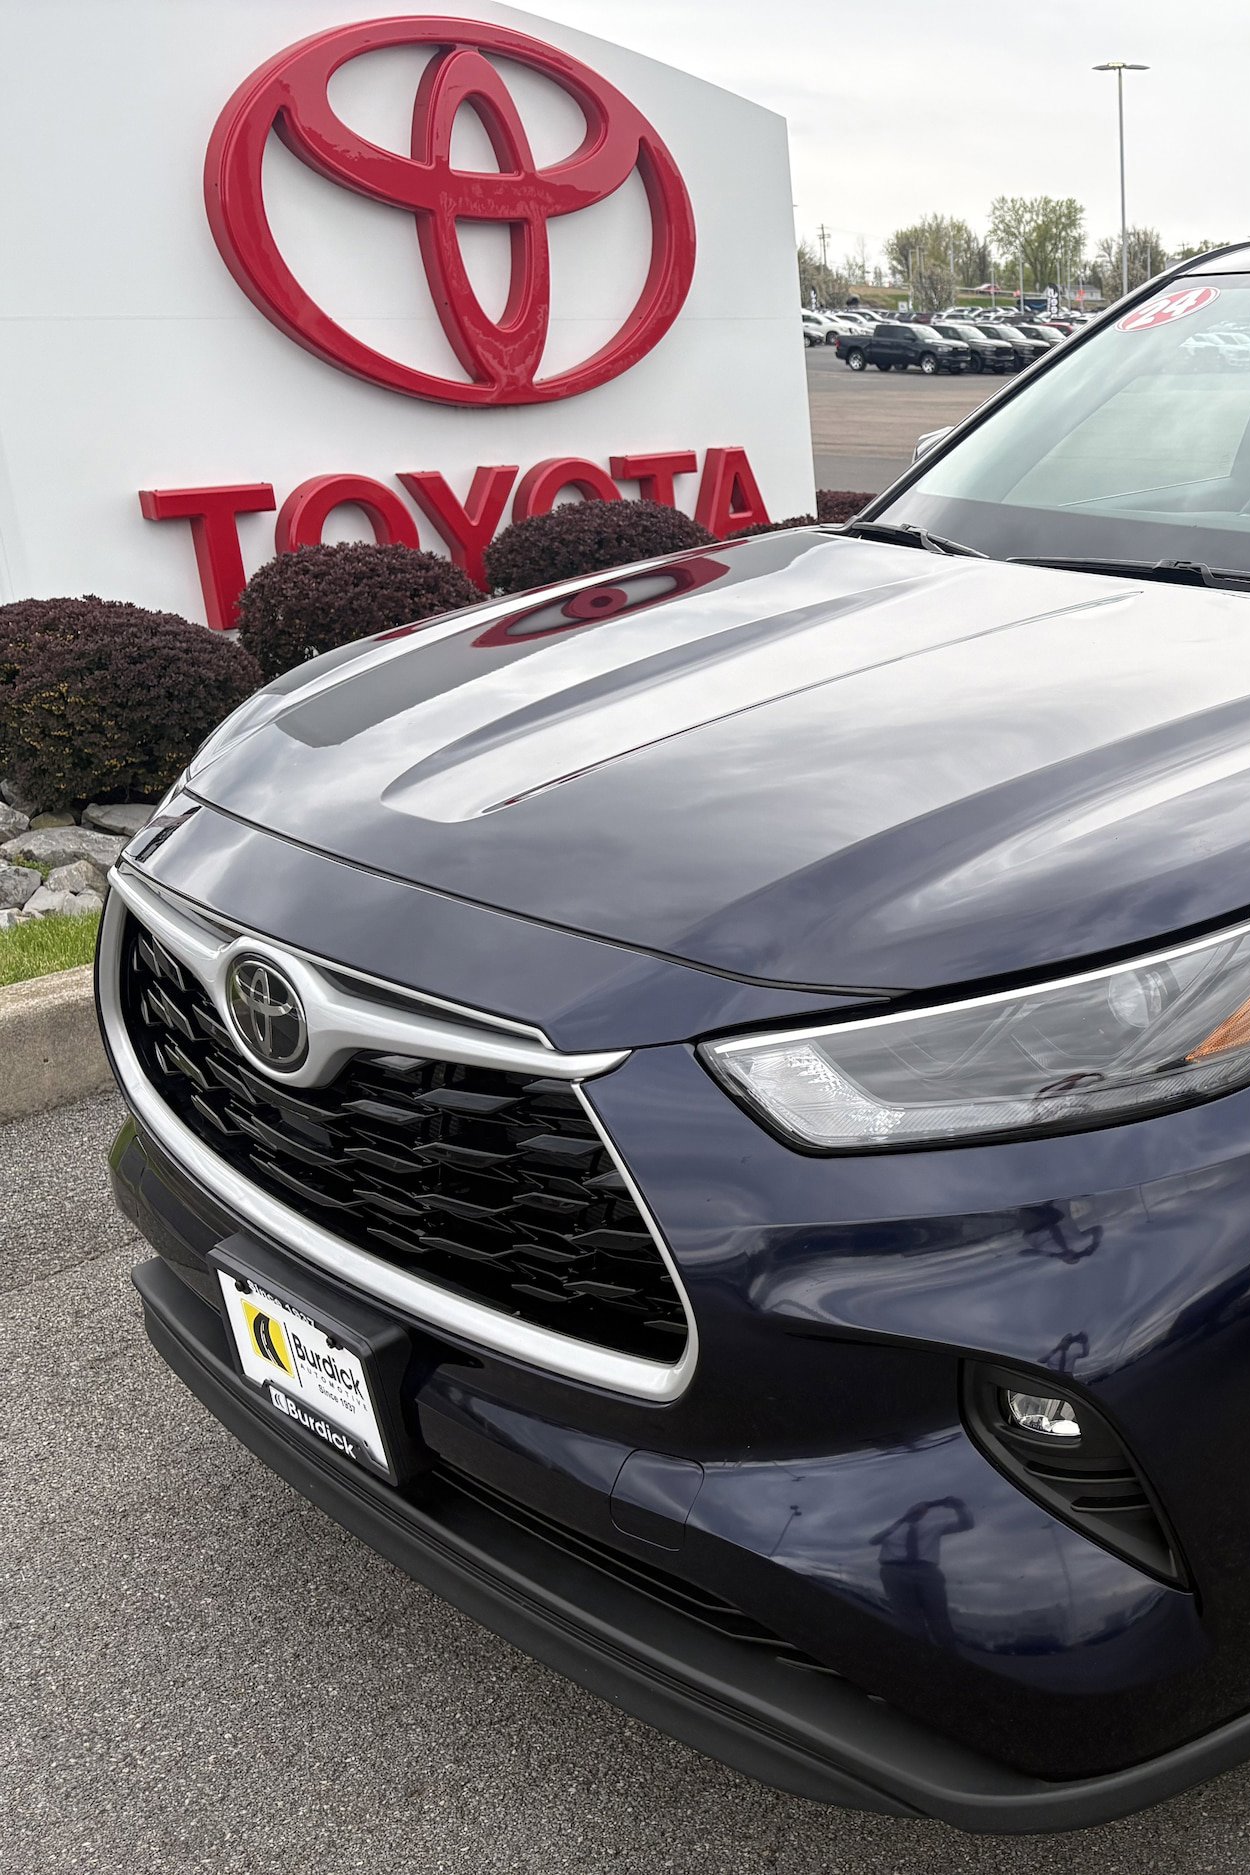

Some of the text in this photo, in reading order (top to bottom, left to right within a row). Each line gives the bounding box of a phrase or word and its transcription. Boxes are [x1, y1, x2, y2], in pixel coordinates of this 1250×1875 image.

[1123, 288, 1211, 330] 24
[138, 446, 770, 631] TOYOTA
[247, 1279, 282, 1308] Since
[291, 1332, 364, 1400] Burdick
[300, 1363, 368, 1411] AUTOMOTIVE
[318, 1384, 339, 1403] Since
[286, 1398, 356, 1459] Burdick
